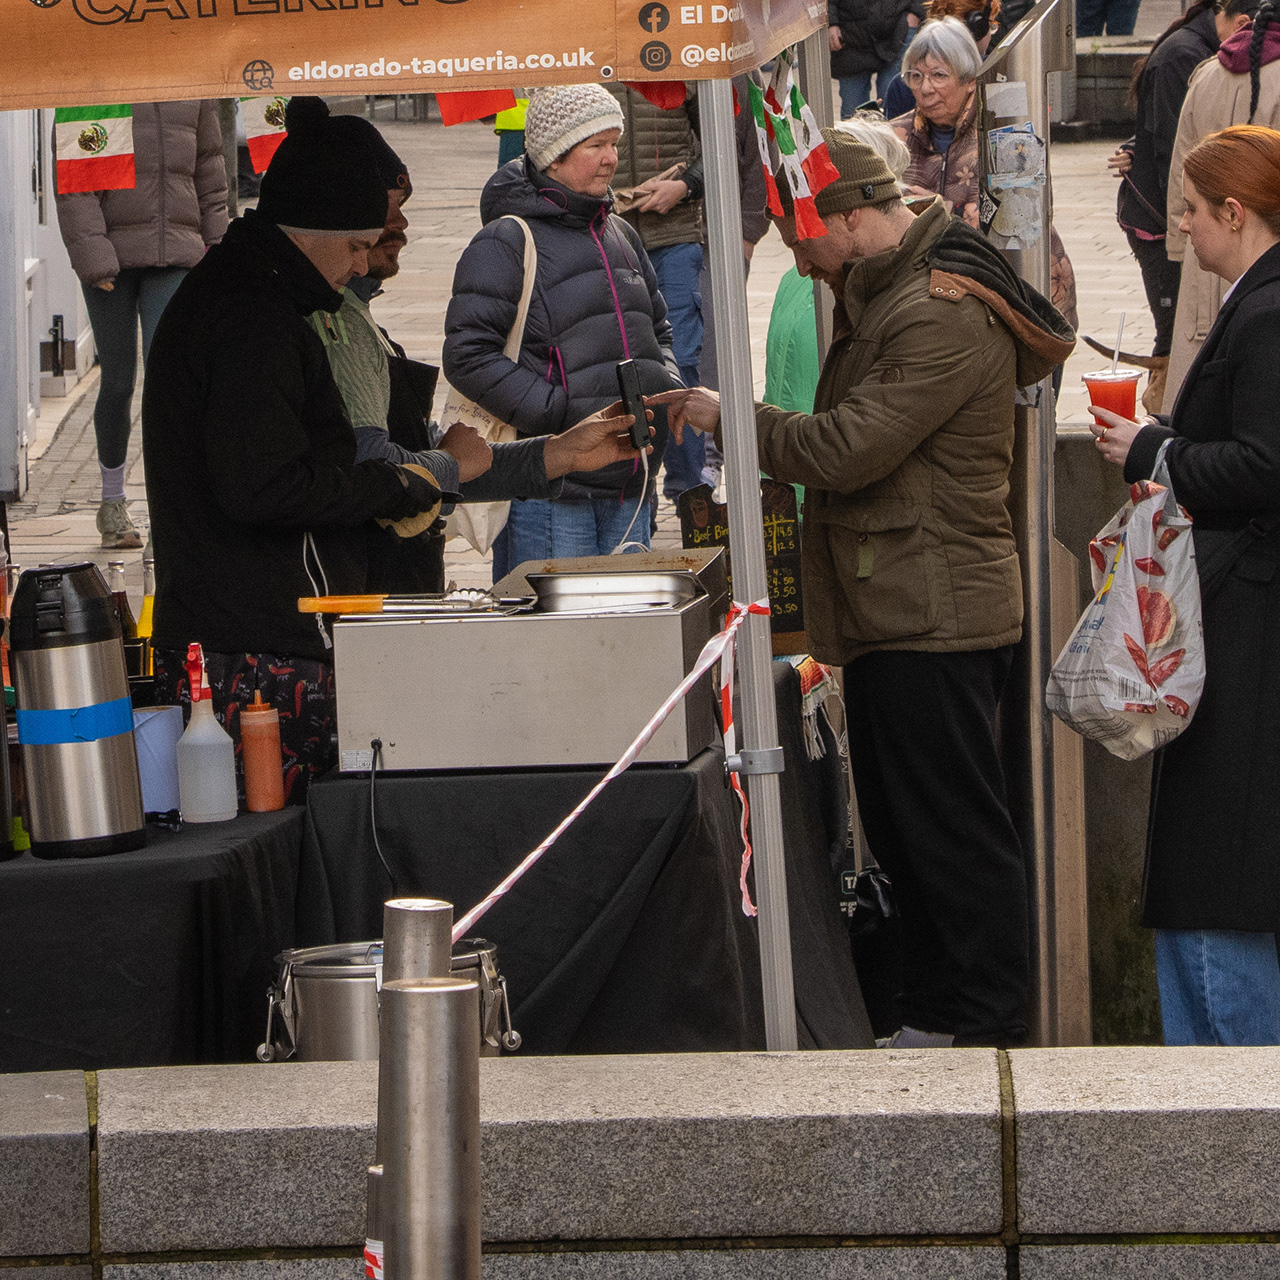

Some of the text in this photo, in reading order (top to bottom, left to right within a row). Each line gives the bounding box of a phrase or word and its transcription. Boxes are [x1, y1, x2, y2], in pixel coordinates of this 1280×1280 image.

[681, 5, 703, 25] El
[288, 48, 595, 81] eldorado-taqueria.co.uk
[773, 603, 798, 615] 3.50
